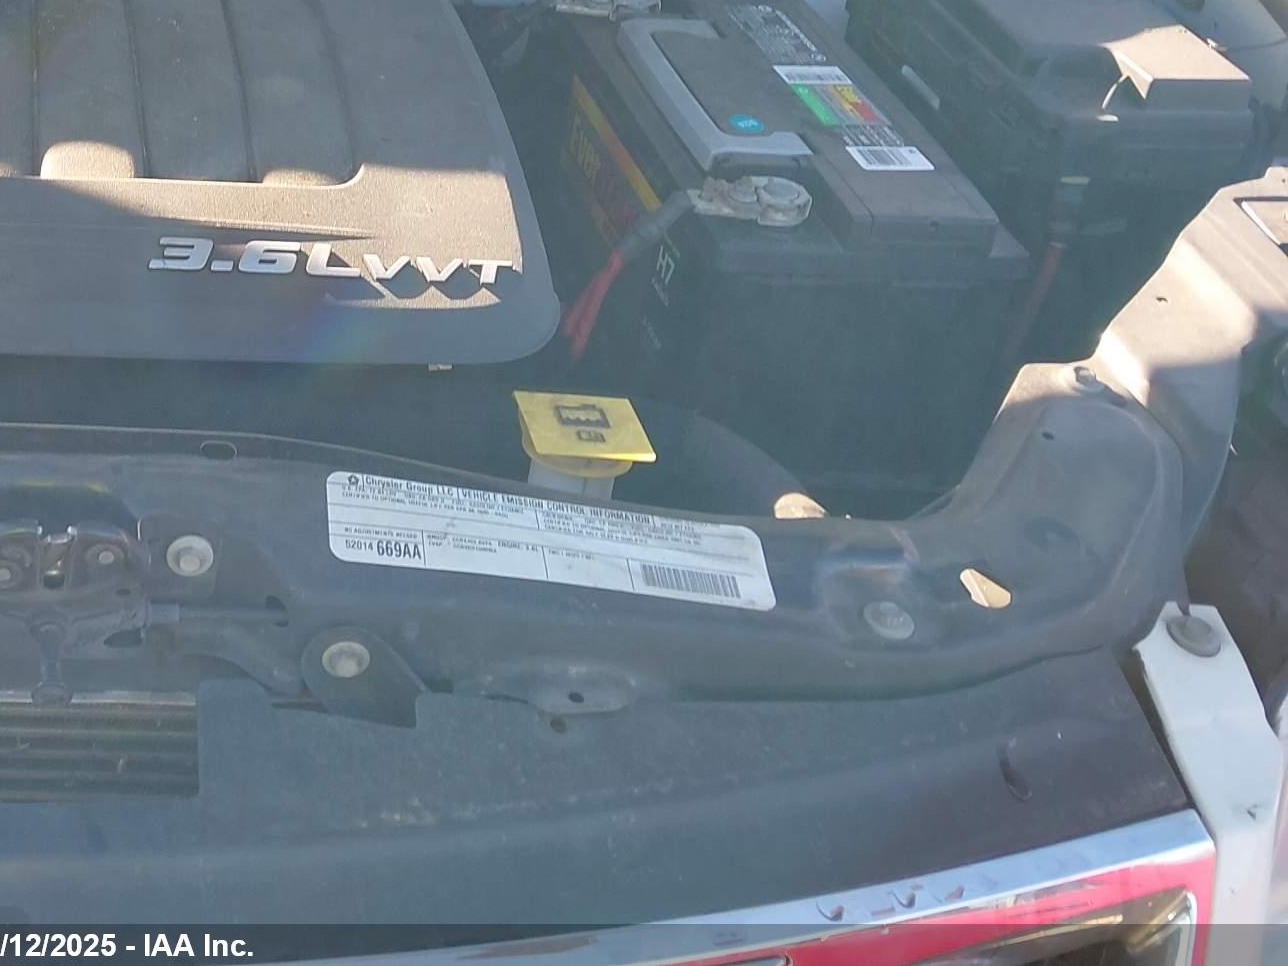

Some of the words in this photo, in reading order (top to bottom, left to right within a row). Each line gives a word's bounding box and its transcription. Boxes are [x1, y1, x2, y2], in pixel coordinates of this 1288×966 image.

[148, 236, 362, 277] 3.6L
[363, 253, 514, 285] VVT
[365, 476, 403, 491] Chrysler
[405, 480, 434, 494] Group
[436, 484, 454, 497] LLC
[462, 488, 497, 503] VEHICLE
[500, 493, 544, 509] EMISSION
[547, 501, 586, 515] CONTROL
[589, 507, 650, 524] INFORMATION
[345, 539, 374, 551] 52014
[376, 540, 422, 560] 669AA
